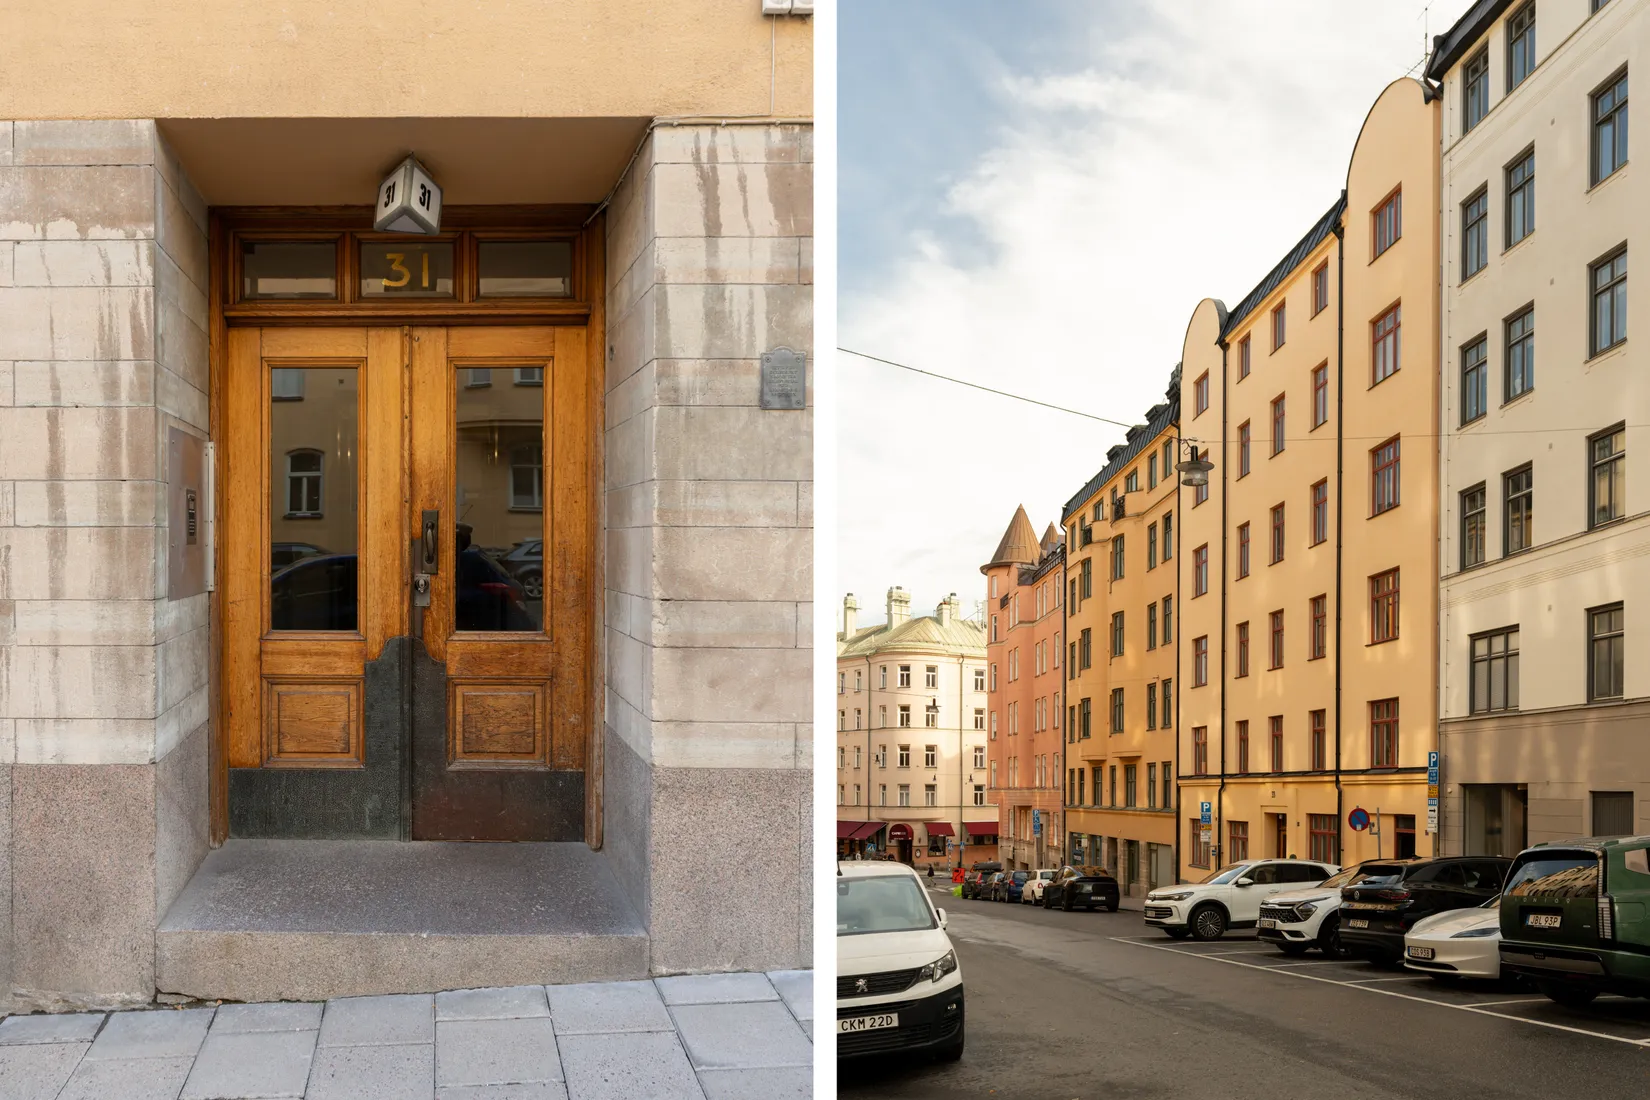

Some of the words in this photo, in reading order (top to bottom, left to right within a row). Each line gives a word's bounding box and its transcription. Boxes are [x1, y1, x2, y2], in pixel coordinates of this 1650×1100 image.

[384, 181, 396, 208] 31
[419, 183, 431, 211] 31
[382, 252, 429, 288] 31
[1430, 753, 1437, 767] P
[1203, 803, 1210, 812] P
[1530, 915, 1542, 926] JBL
[1544, 916, 1559, 927] 93P
[841, 1017, 866, 1031] CKM
[869, 1015, 893, 1028] 22D
